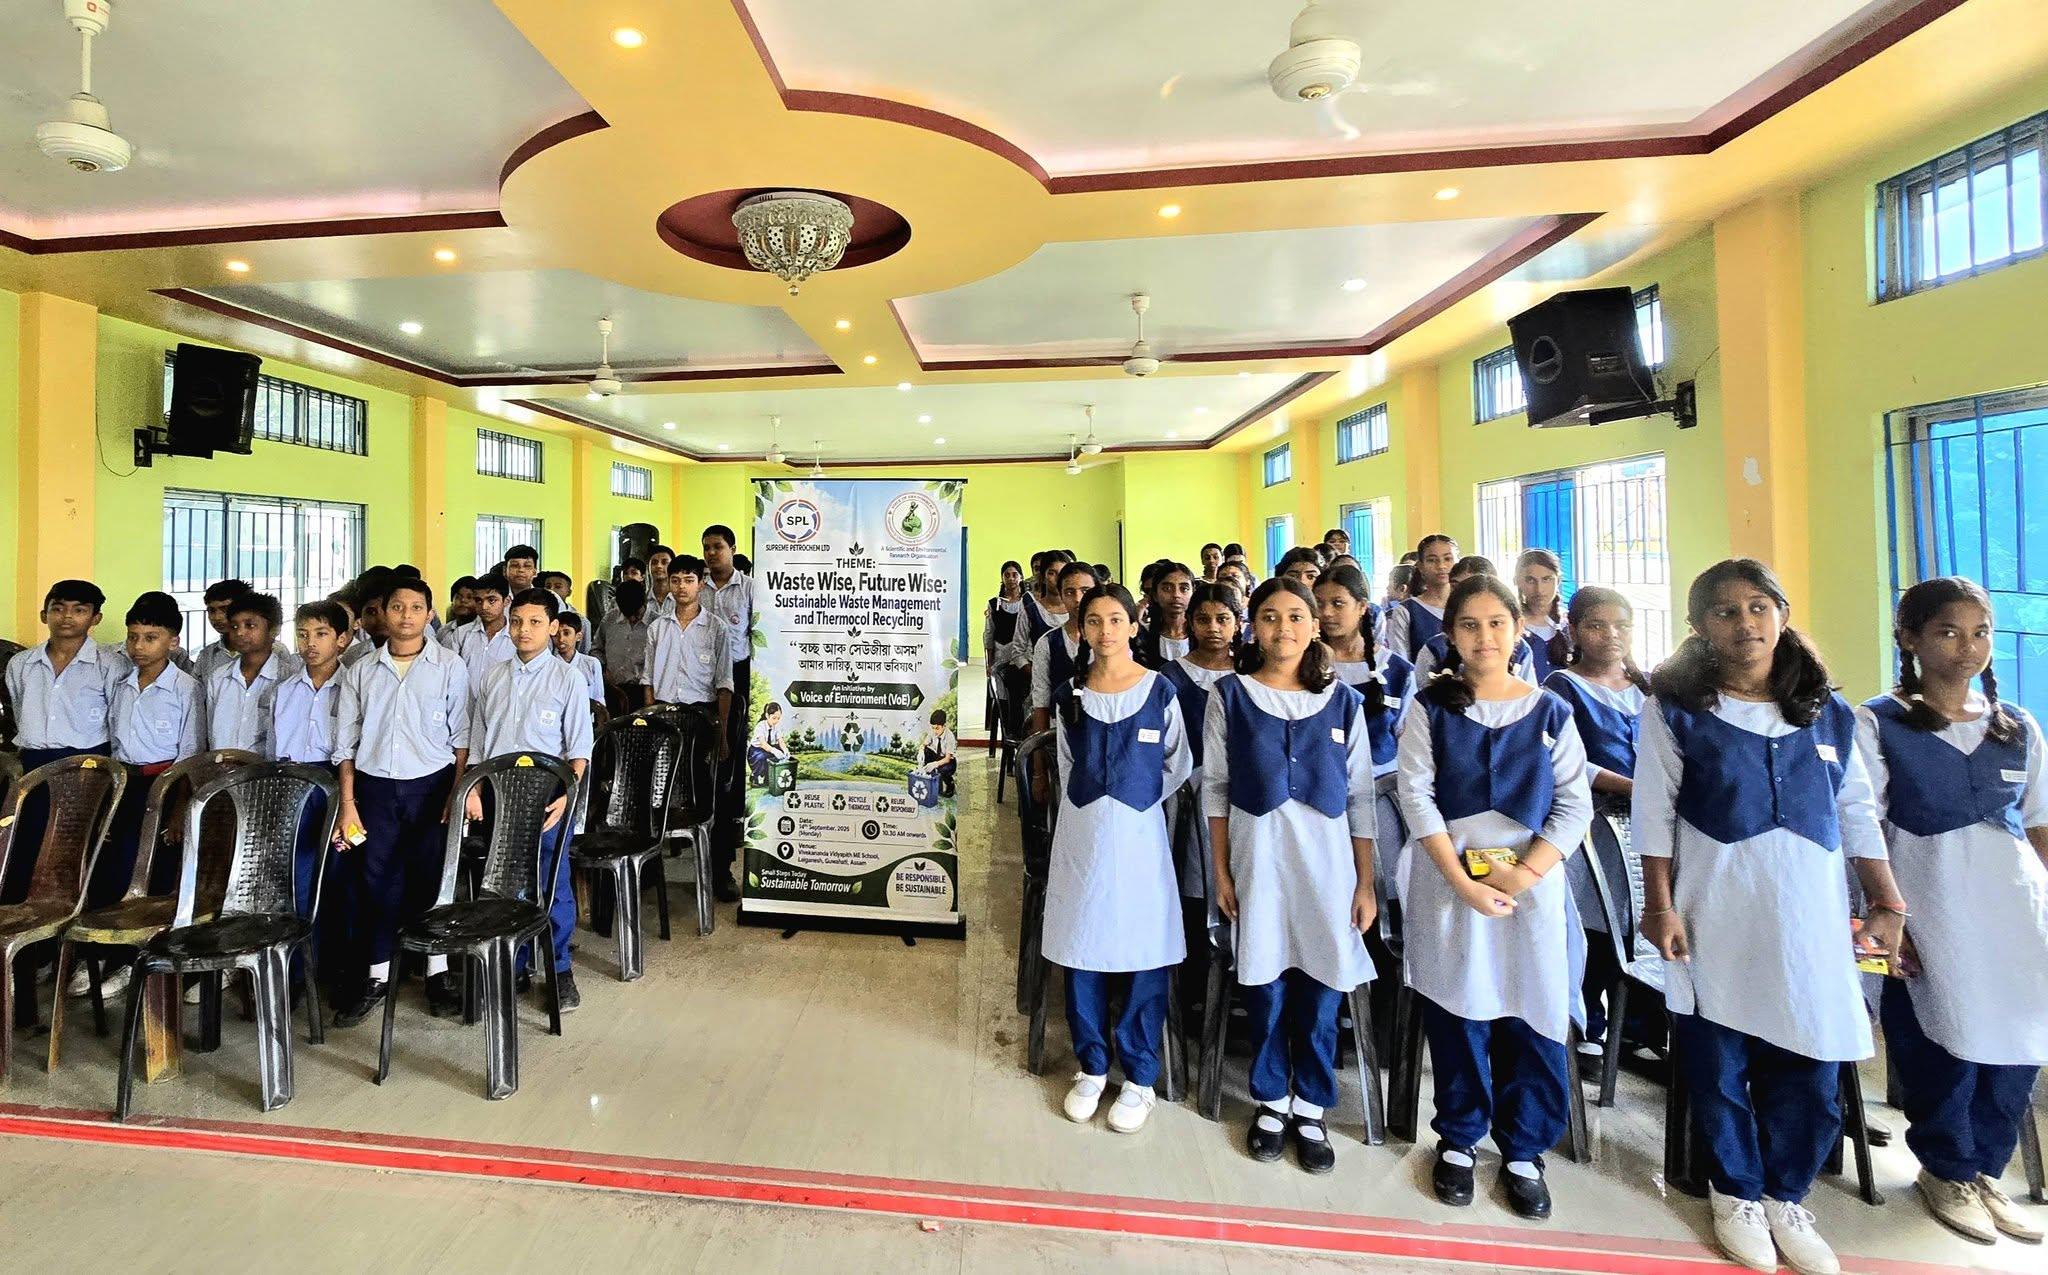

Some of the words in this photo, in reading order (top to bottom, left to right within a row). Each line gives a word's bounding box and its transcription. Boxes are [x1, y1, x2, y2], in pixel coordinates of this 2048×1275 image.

[787, 516, 809, 526] SPL
[766, 544, 789, 552] SUPREME
[790, 544, 820, 552] PETROCHEM
[821, 544, 831, 552] LTD
[836, 558, 876, 569] THEME:
[767, 571, 815, 591] Waste
[817, 571, 856, 594] Wise,
[859, 572, 906, 592] Future
[908, 572, 947, 593] Wise:
[775, 594, 837, 609] Sustainable
[839, 595, 870, 609] Waste
[872, 595, 941, 613] Management
[794, 611, 814, 625] and
[816, 611, 870, 626] Thermocol
[873, 612, 924, 630] Recycling
[800, 691, 823, 703] Voice
[825, 692, 834, 703] of
[834, 692, 887, 705] Environment
[888, 693, 911, 706] (VoE)
[862, 852, 880, 860] School,
[776, 869, 790, 877] Steps
[791, 870, 808, 879] Today
[896, 872, 904, 881] BE
[905, 873, 946, 883] RESPONSIBLE
[760, 876, 809, 890] Sustainable
[810, 879, 851, 892] Tomorrow
[895, 883, 904, 892] BE
[904, 884, 946, 895] SUSTAINABLE
